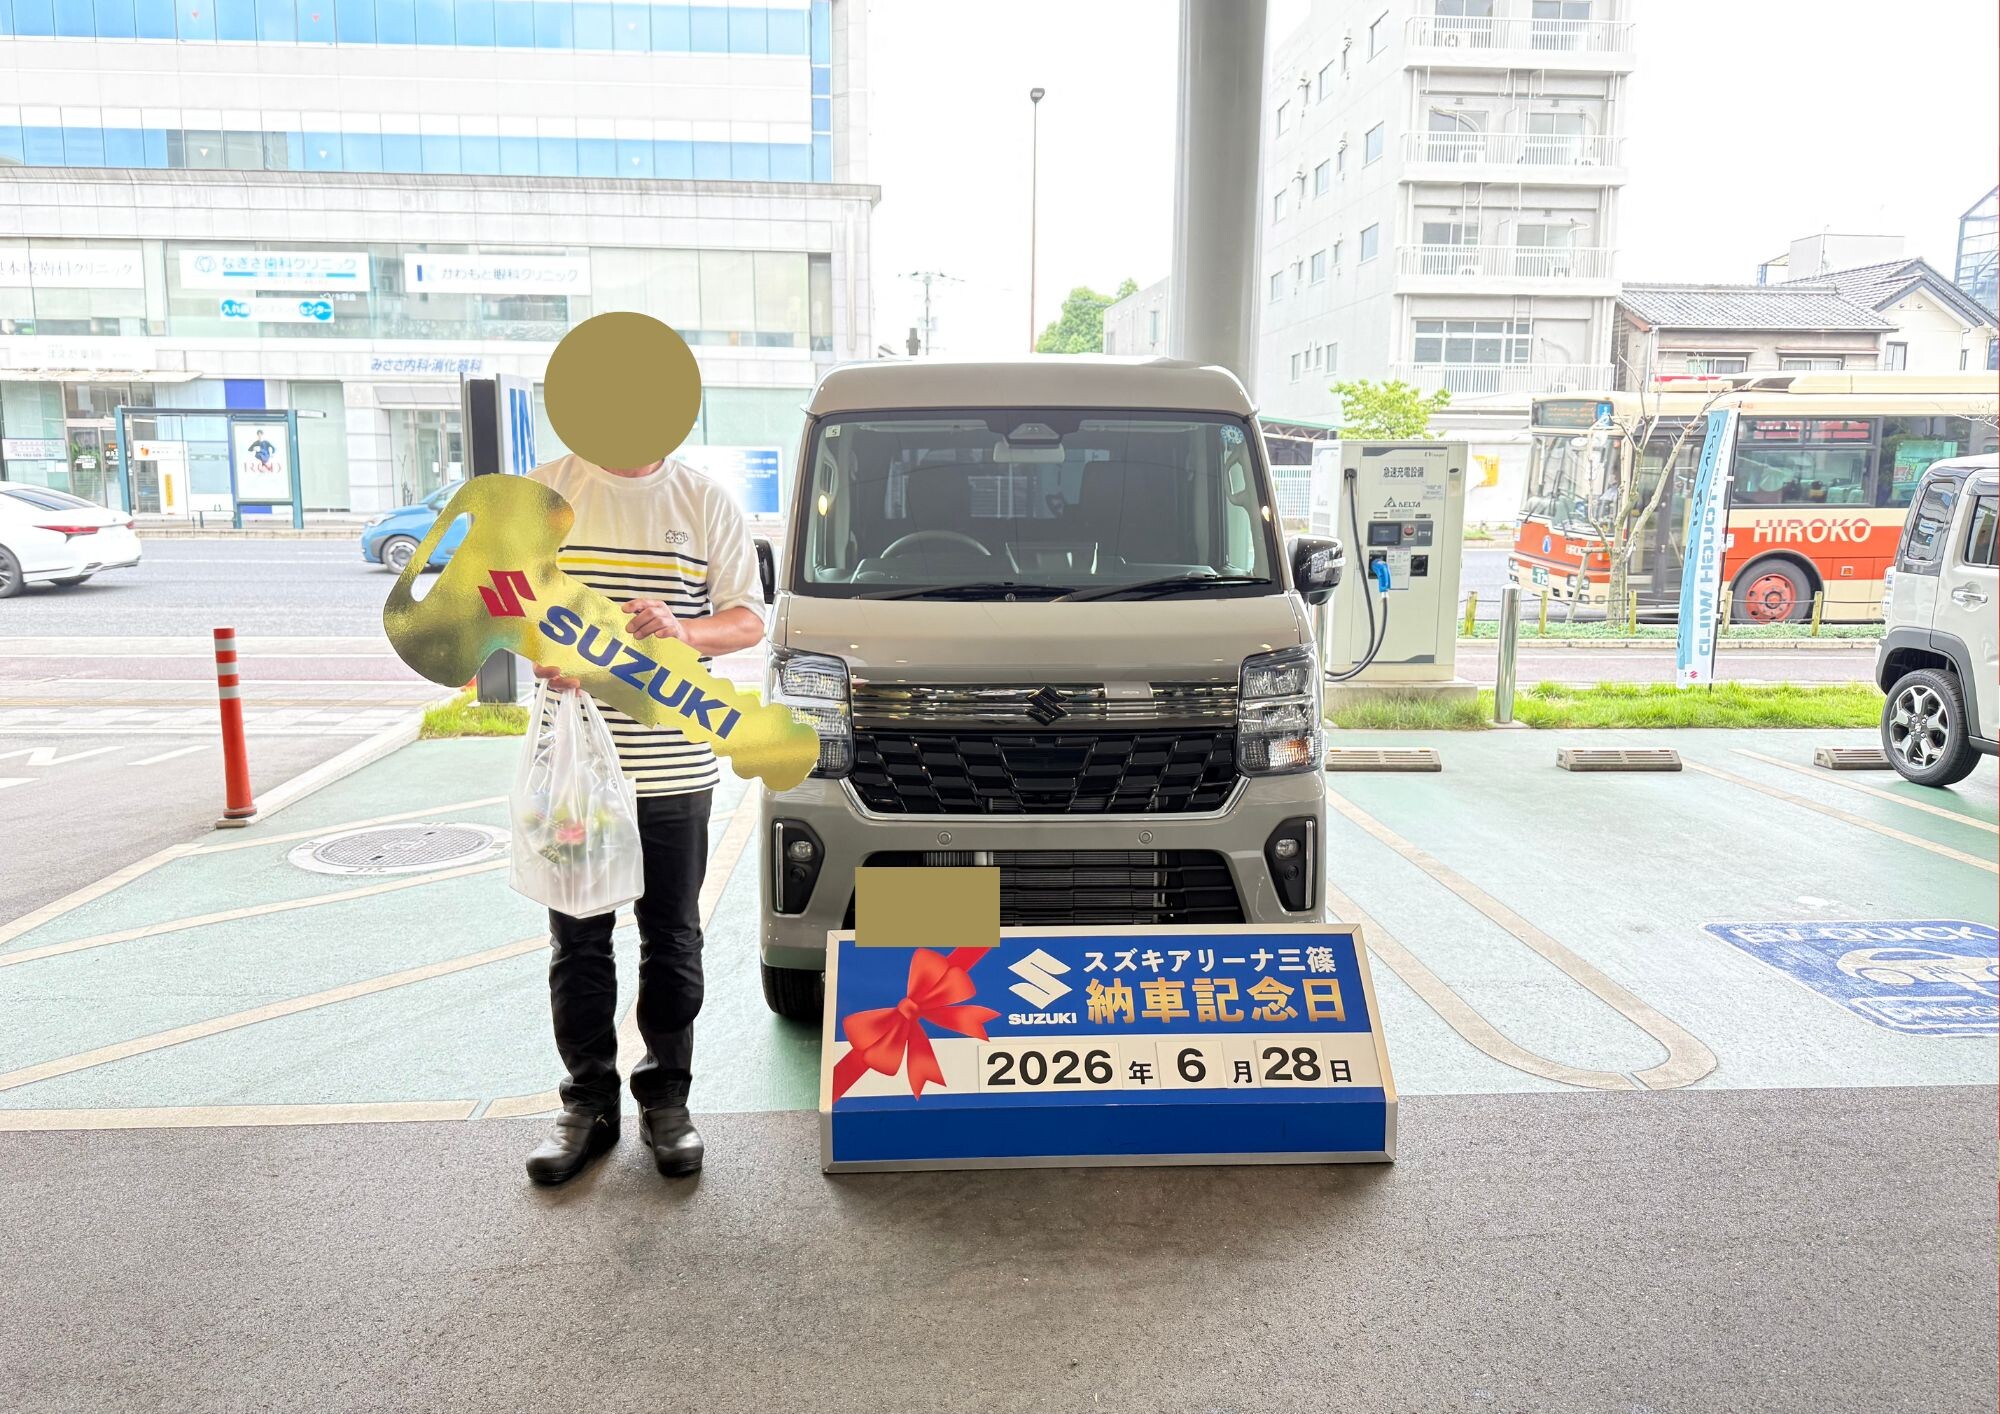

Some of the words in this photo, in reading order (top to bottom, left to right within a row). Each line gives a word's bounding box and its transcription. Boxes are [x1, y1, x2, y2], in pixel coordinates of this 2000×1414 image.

[222, 256, 357, 271] なぎさ歯科クリニック
[440, 267, 578, 282] かわもと眼科クリニック
[299, 304, 333, 317] センター
[1383, 466, 1424, 478] 急速充電設備
[1752, 518, 1872, 544] HIROKO
[538, 605, 742, 740] SUZUKI
[1083, 945, 1337, 975] スズキアリーナ三篠
[1086, 976, 1347, 1025] 納車記念日
[1008, 1012, 1077, 1026] SUZUKI
[986, 1049, 1114, 1086] 2026
[1176, 1047, 1207, 1083] 6
[1262, 1046, 1321, 1082] 28
